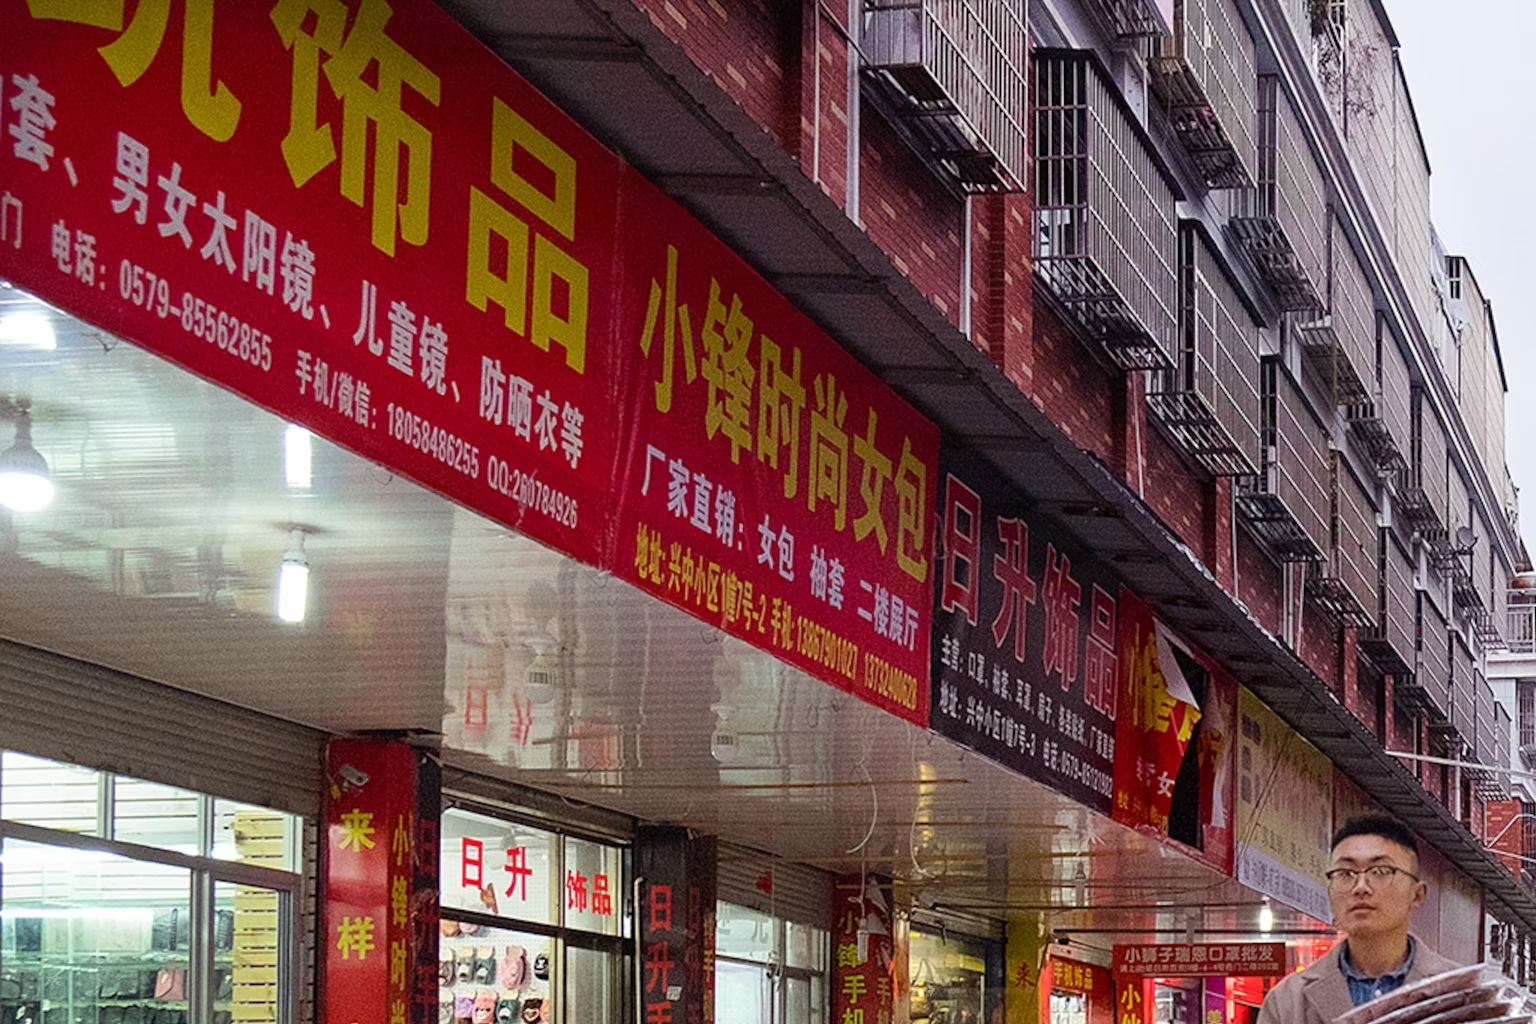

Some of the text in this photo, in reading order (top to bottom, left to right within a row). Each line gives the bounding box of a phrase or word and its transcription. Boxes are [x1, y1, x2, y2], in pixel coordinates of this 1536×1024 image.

[0, 73, 584, 470] 套、男女太阳镜、儿童镜、防晒衣等
[640, 243, 928, 583] 小锋时尚女包
[809, 544, 846, 611] 袖套
[857, 579, 919, 651] 二楼展厅
[941, 472, 1118, 721] 日升饰品
[1053, 960, 1094, 990] 手机饰品
